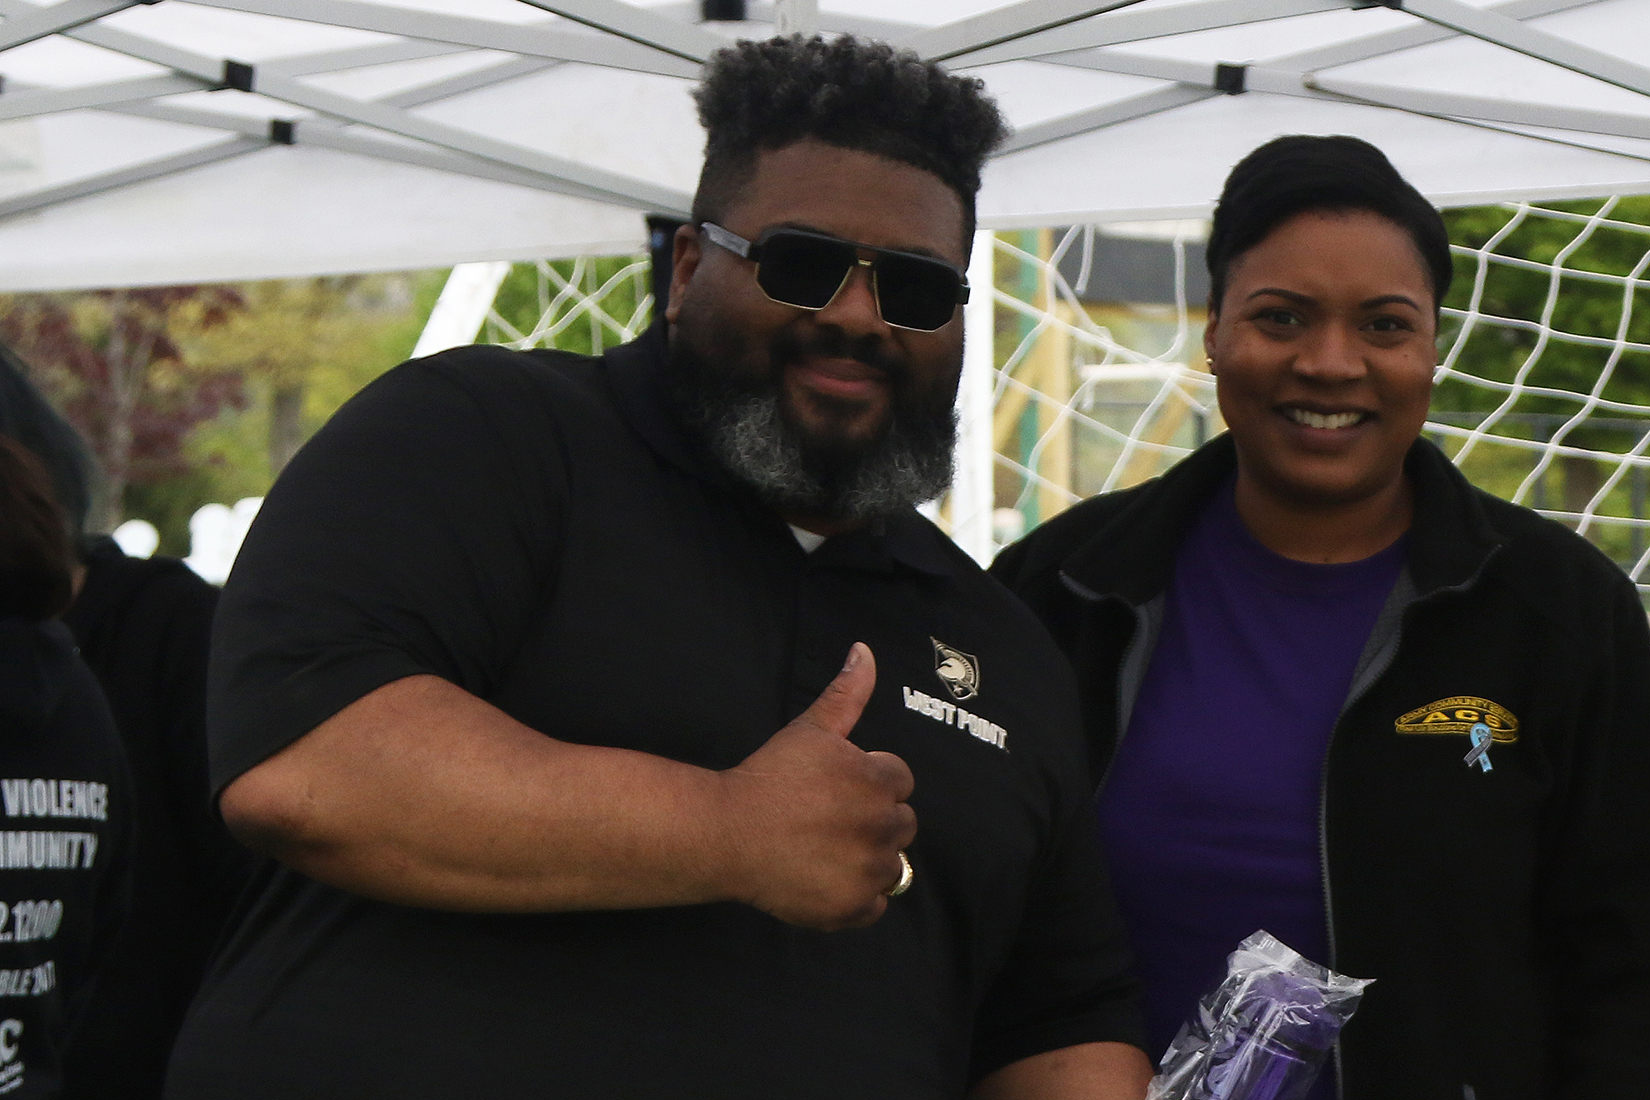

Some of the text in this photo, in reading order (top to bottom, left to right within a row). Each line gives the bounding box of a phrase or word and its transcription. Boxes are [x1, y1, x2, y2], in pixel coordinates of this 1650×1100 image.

[1421, 709, 1501, 728] ACS
[1, 778, 108, 821] VIOLENCE
[0, 831, 98, 869] MUNITY
